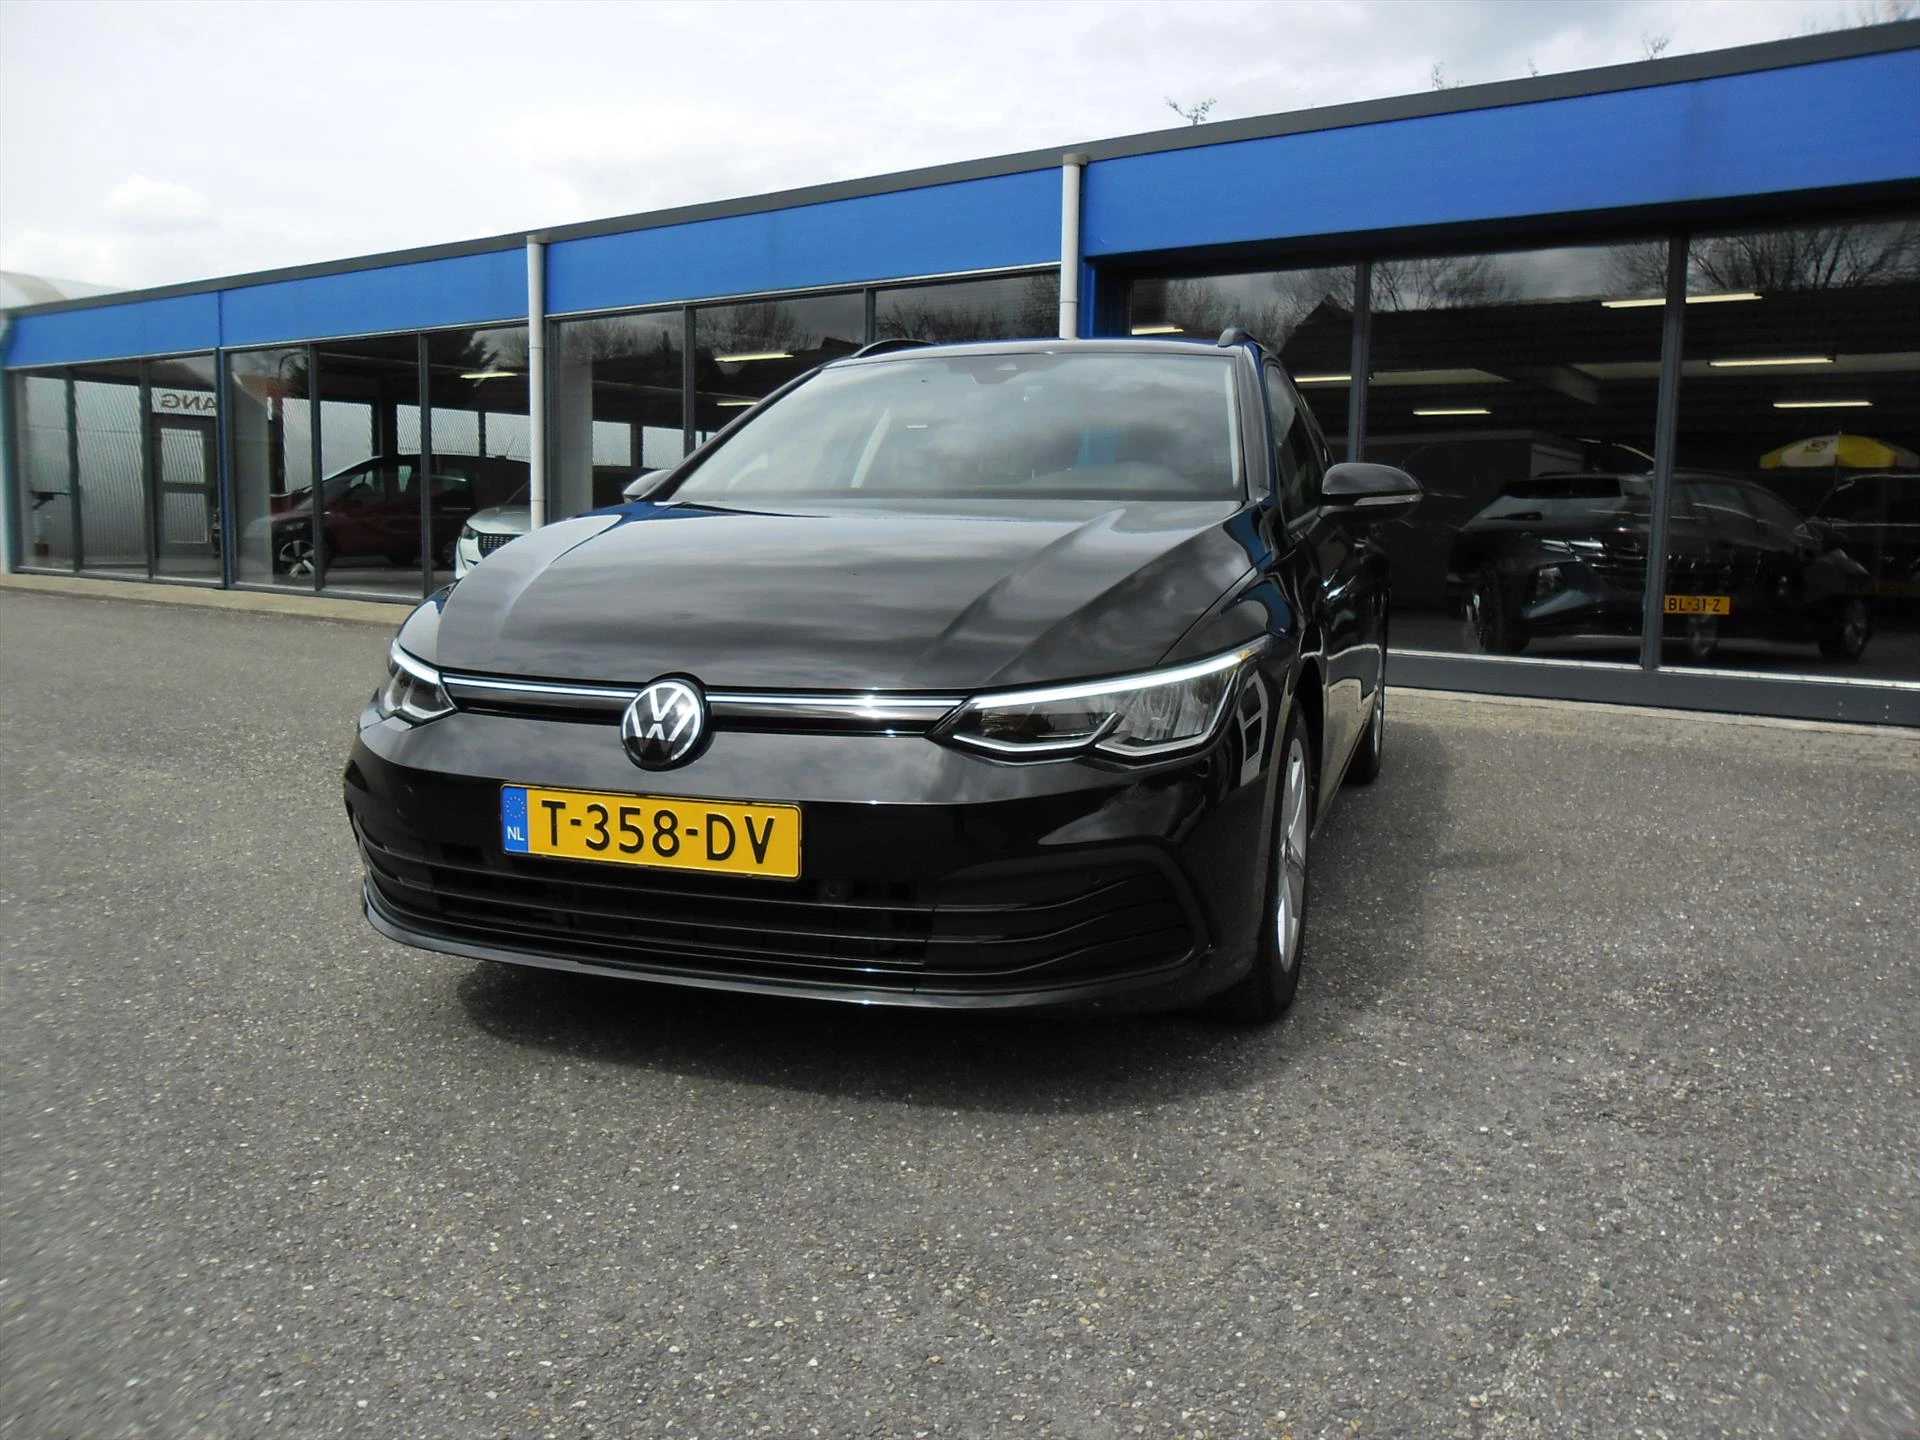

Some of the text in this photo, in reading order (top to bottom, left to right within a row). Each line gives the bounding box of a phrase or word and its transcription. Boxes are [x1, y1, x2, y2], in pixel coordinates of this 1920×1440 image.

[1664, 598, 1721, 612] BL-31-Z
[507, 826, 525, 842] NL
[541, 799, 776, 864] T-358-DV
